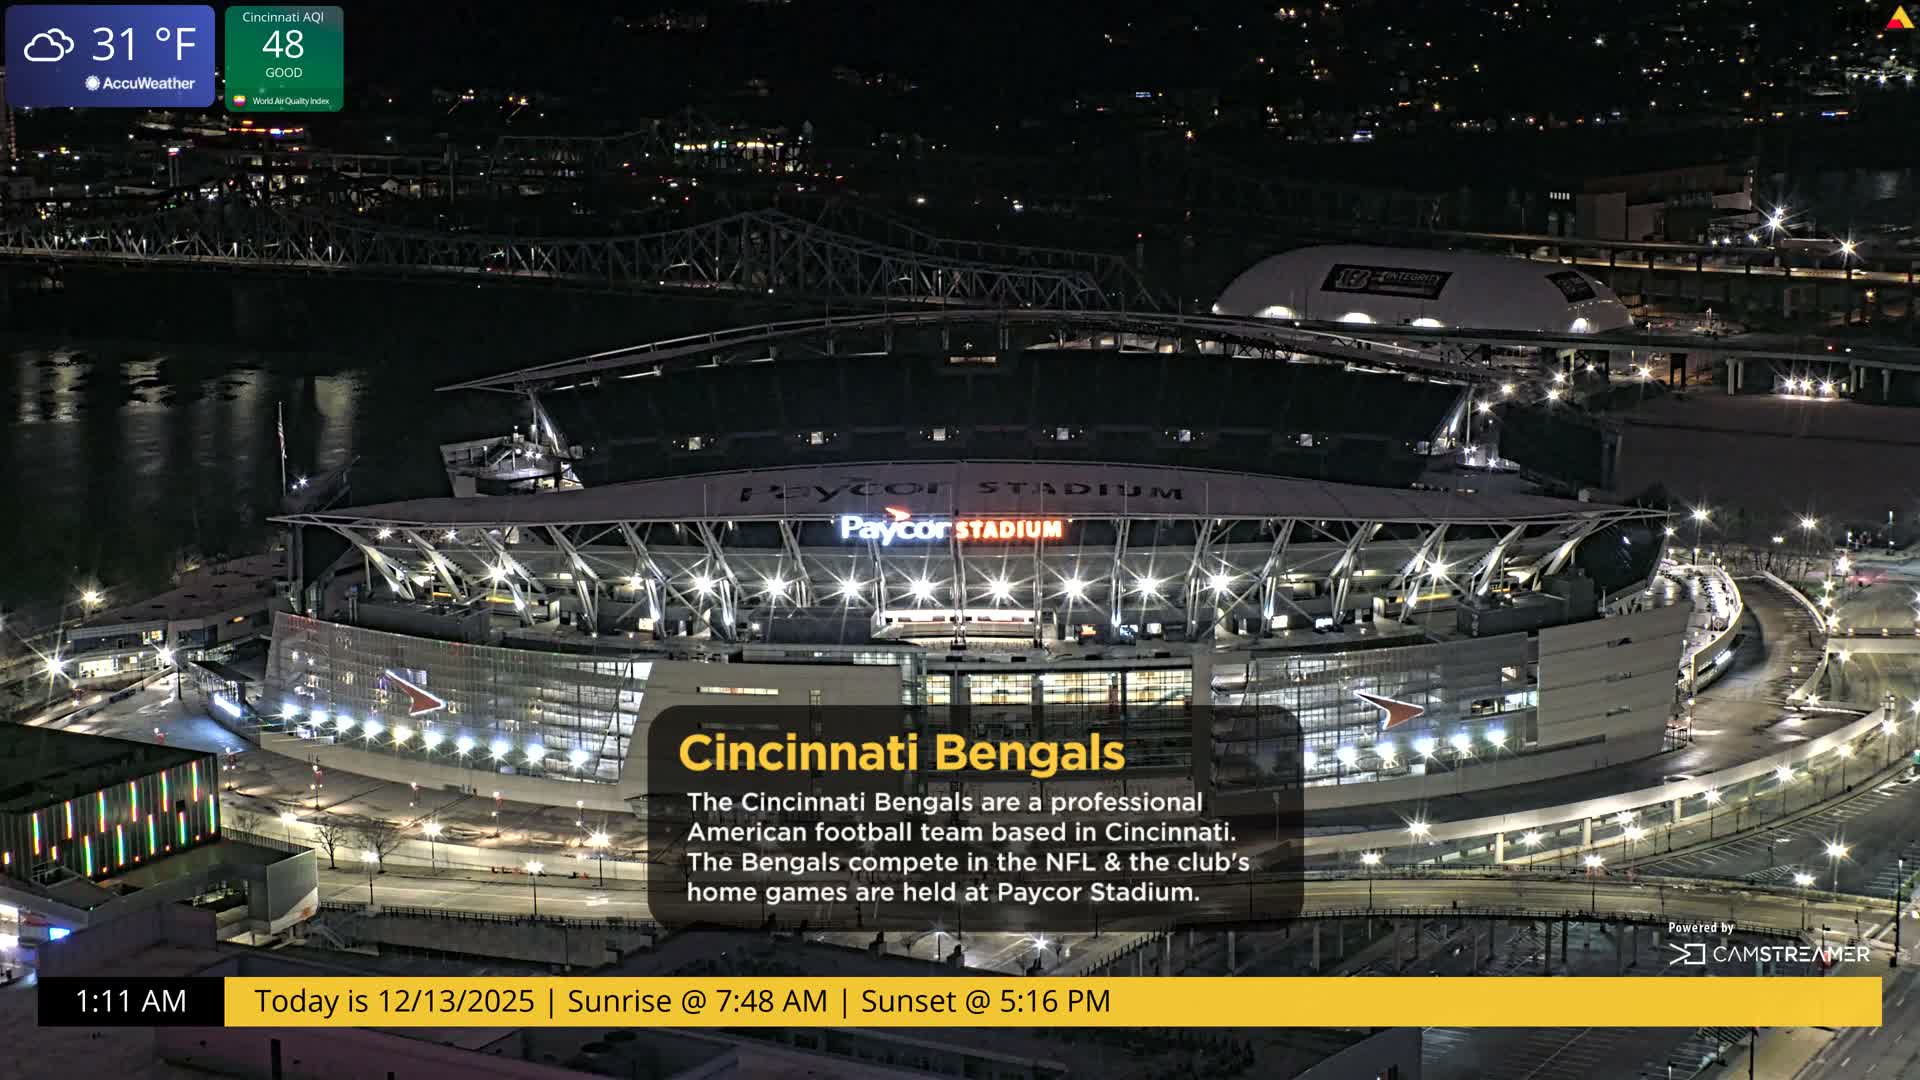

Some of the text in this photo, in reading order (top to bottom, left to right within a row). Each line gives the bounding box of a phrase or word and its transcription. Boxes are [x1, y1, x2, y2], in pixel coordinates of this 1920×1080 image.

[977, 481, 1183, 500] STADIUM
[841, 515, 1063, 546] Paycor STADIUM
